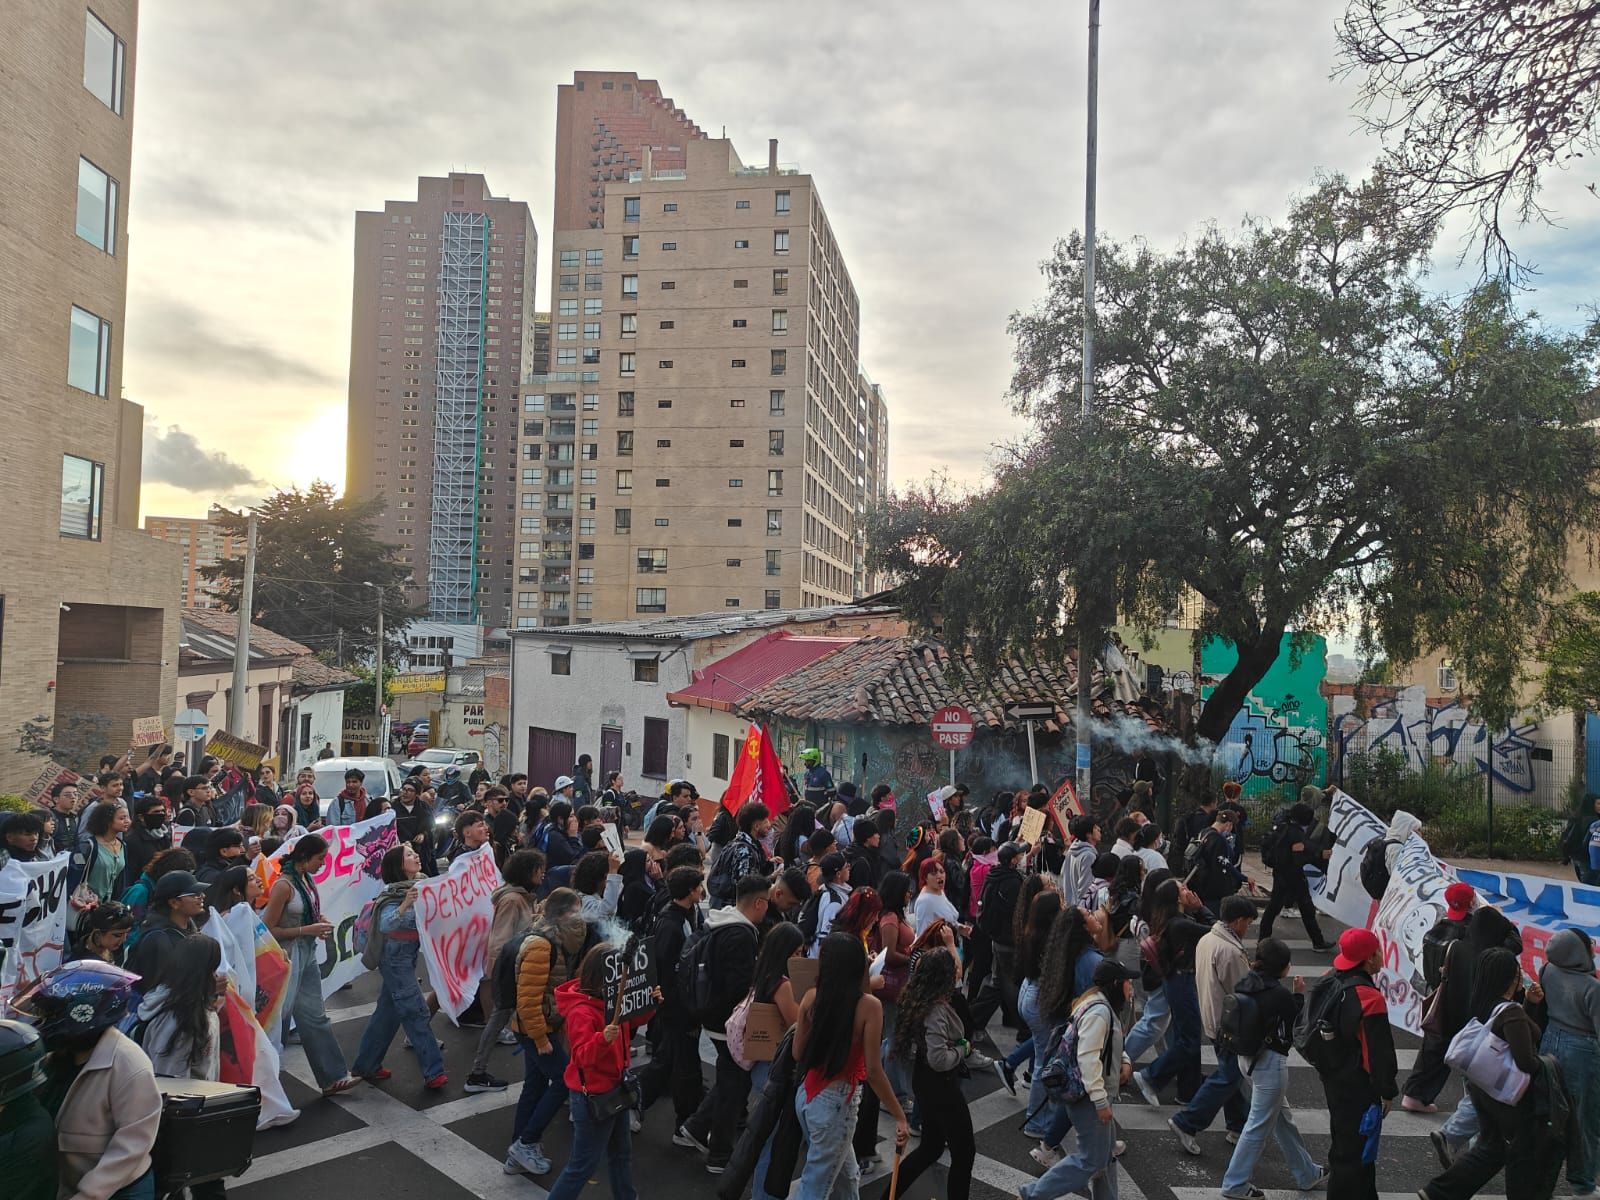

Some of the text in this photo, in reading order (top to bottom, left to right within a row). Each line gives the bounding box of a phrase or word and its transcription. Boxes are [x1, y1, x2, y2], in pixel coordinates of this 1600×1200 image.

[389, 673, 447, 684] ARQUEADERO
[463, 704, 484, 716] PAR
[944, 711, 960, 722] NO
[344, 718, 371, 730] DERO
[939, 733, 968, 745] PASE
[607, 985, 615, 998] ES
[607, 1000, 614, 1009] AL
